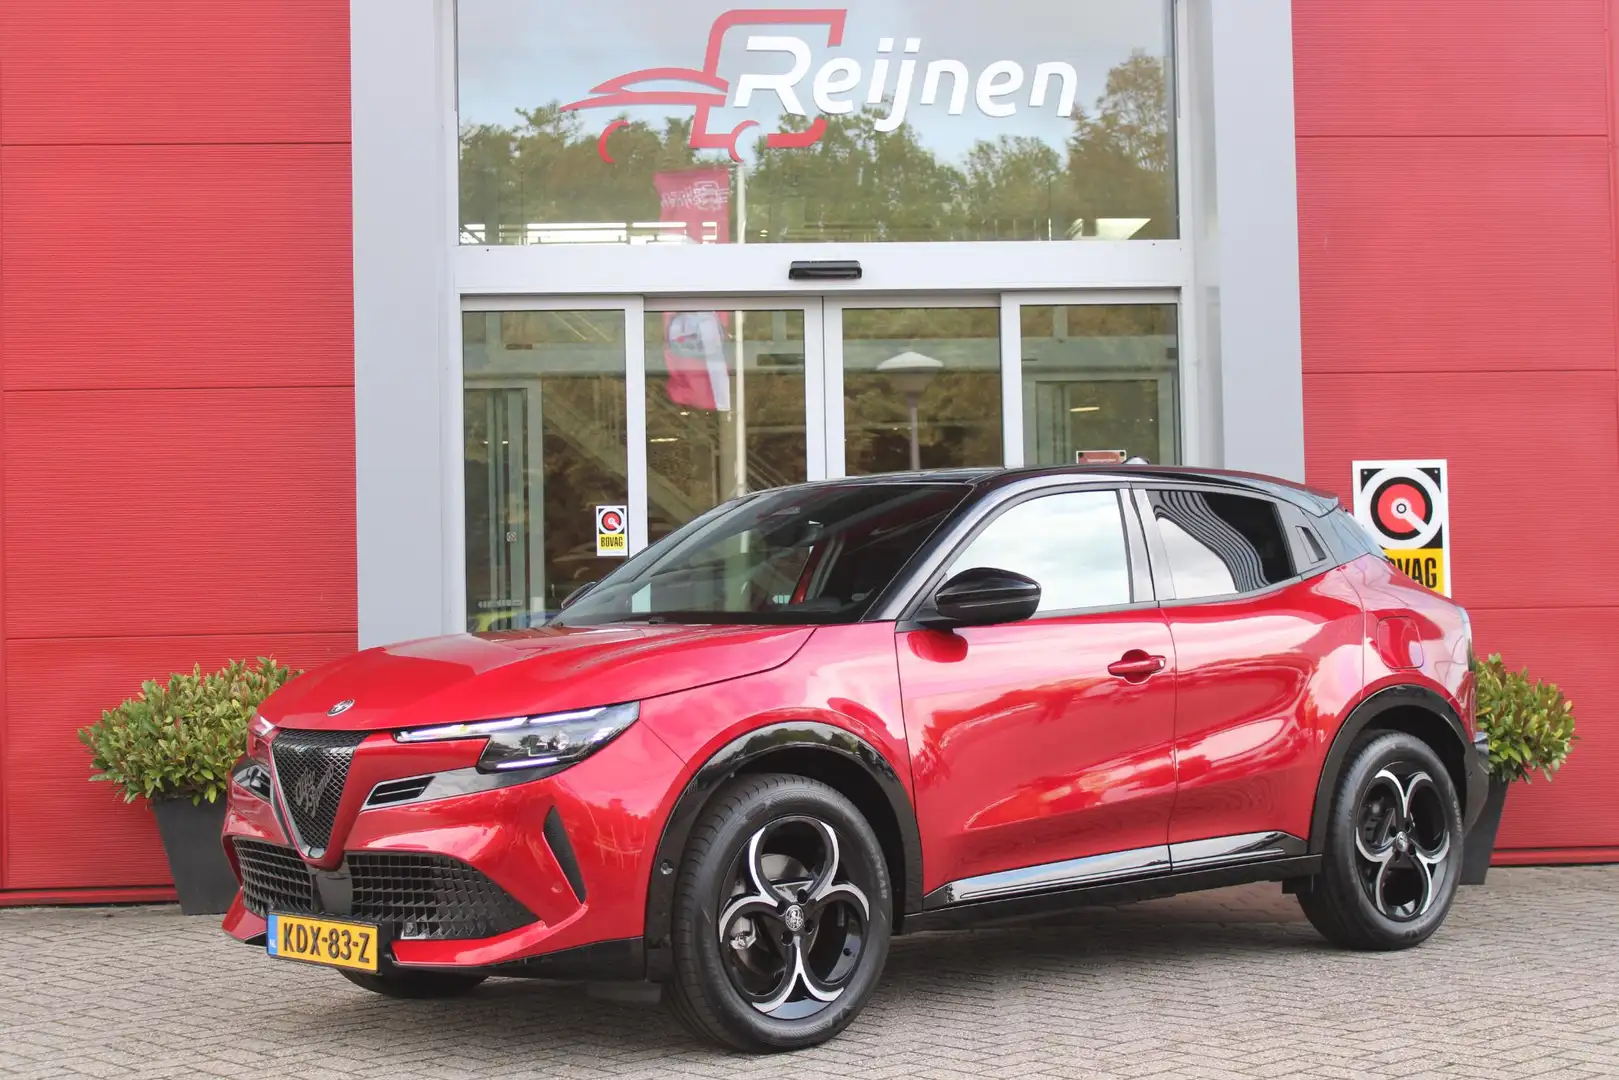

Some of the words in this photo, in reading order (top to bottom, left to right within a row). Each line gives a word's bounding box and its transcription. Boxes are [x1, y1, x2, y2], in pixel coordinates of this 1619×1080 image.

[734, 35, 1078, 132] Reijnen
[600, 536, 623, 548] BOVAG
[283, 922, 370, 964] KDX-83-Z
